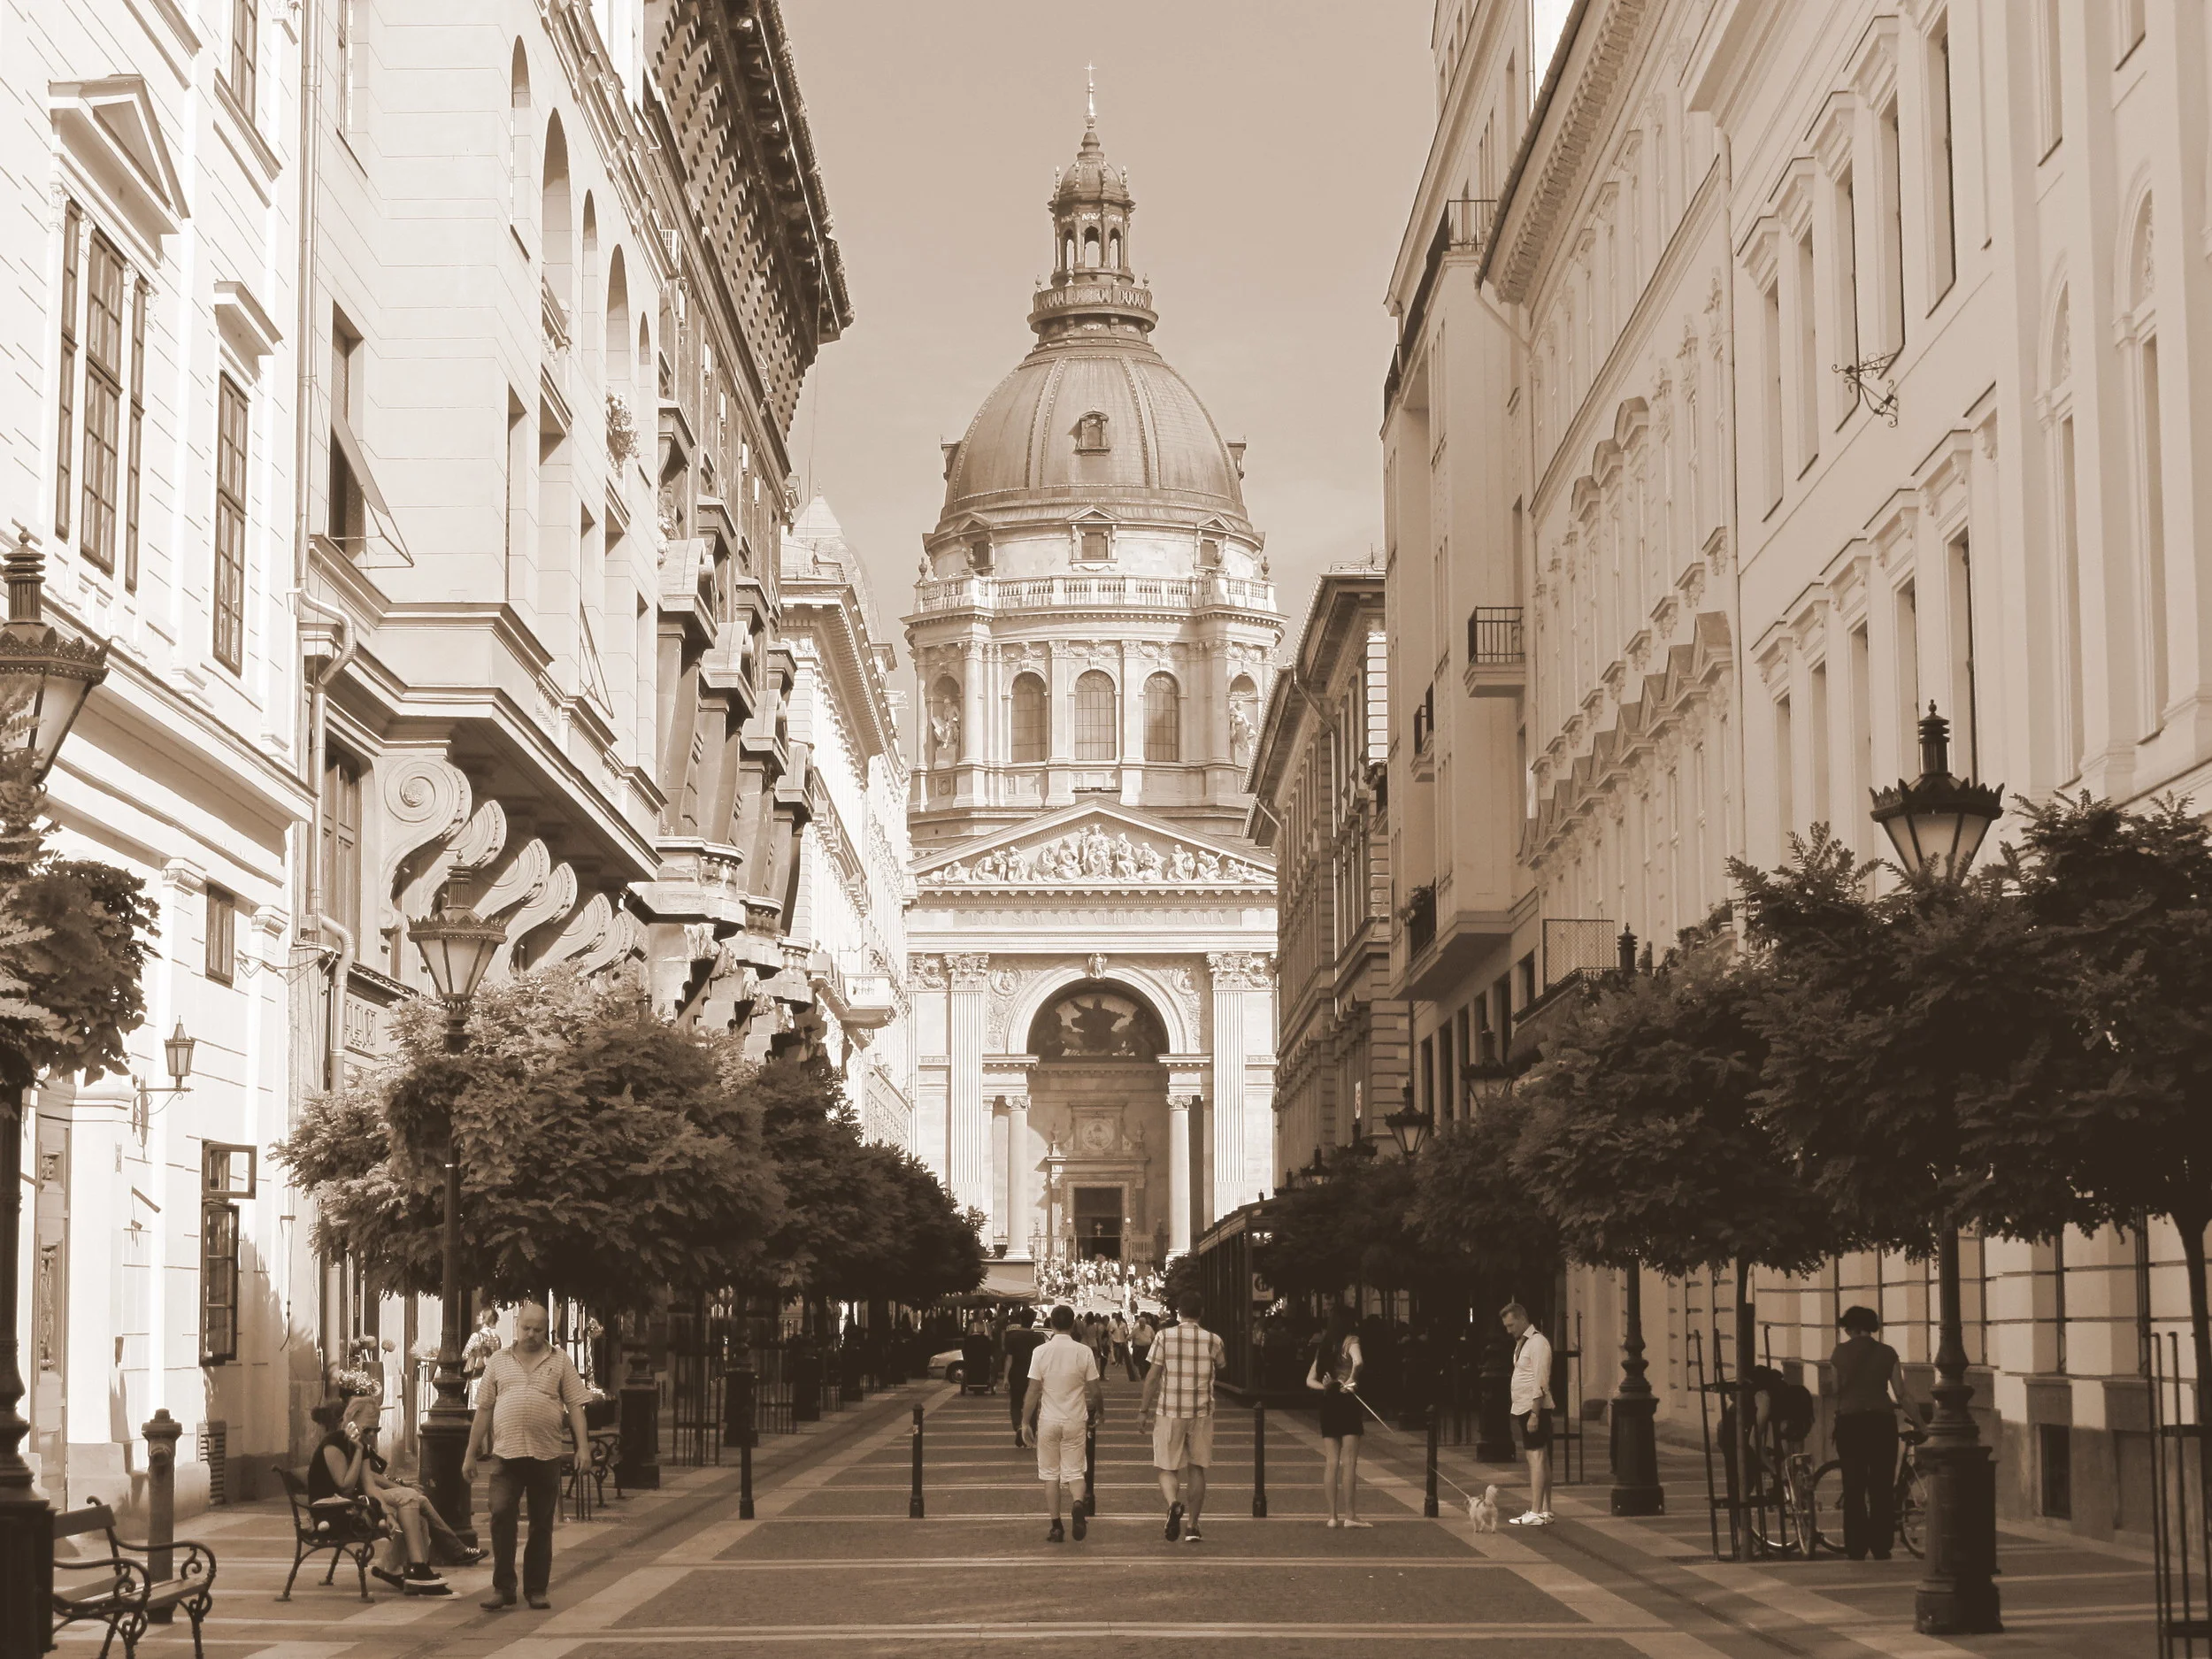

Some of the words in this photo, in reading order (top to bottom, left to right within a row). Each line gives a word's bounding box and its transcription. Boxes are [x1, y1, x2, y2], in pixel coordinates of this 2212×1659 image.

[970, 910, 1001, 925] EGO
[1012, 910, 1045, 925] SUM
[1055, 910, 1082, 925] VIA
[1092, 910, 1154, 925] VERITAS
[1165, 910, 1180, 925] ET
[1192, 910, 1225, 925] VITA
